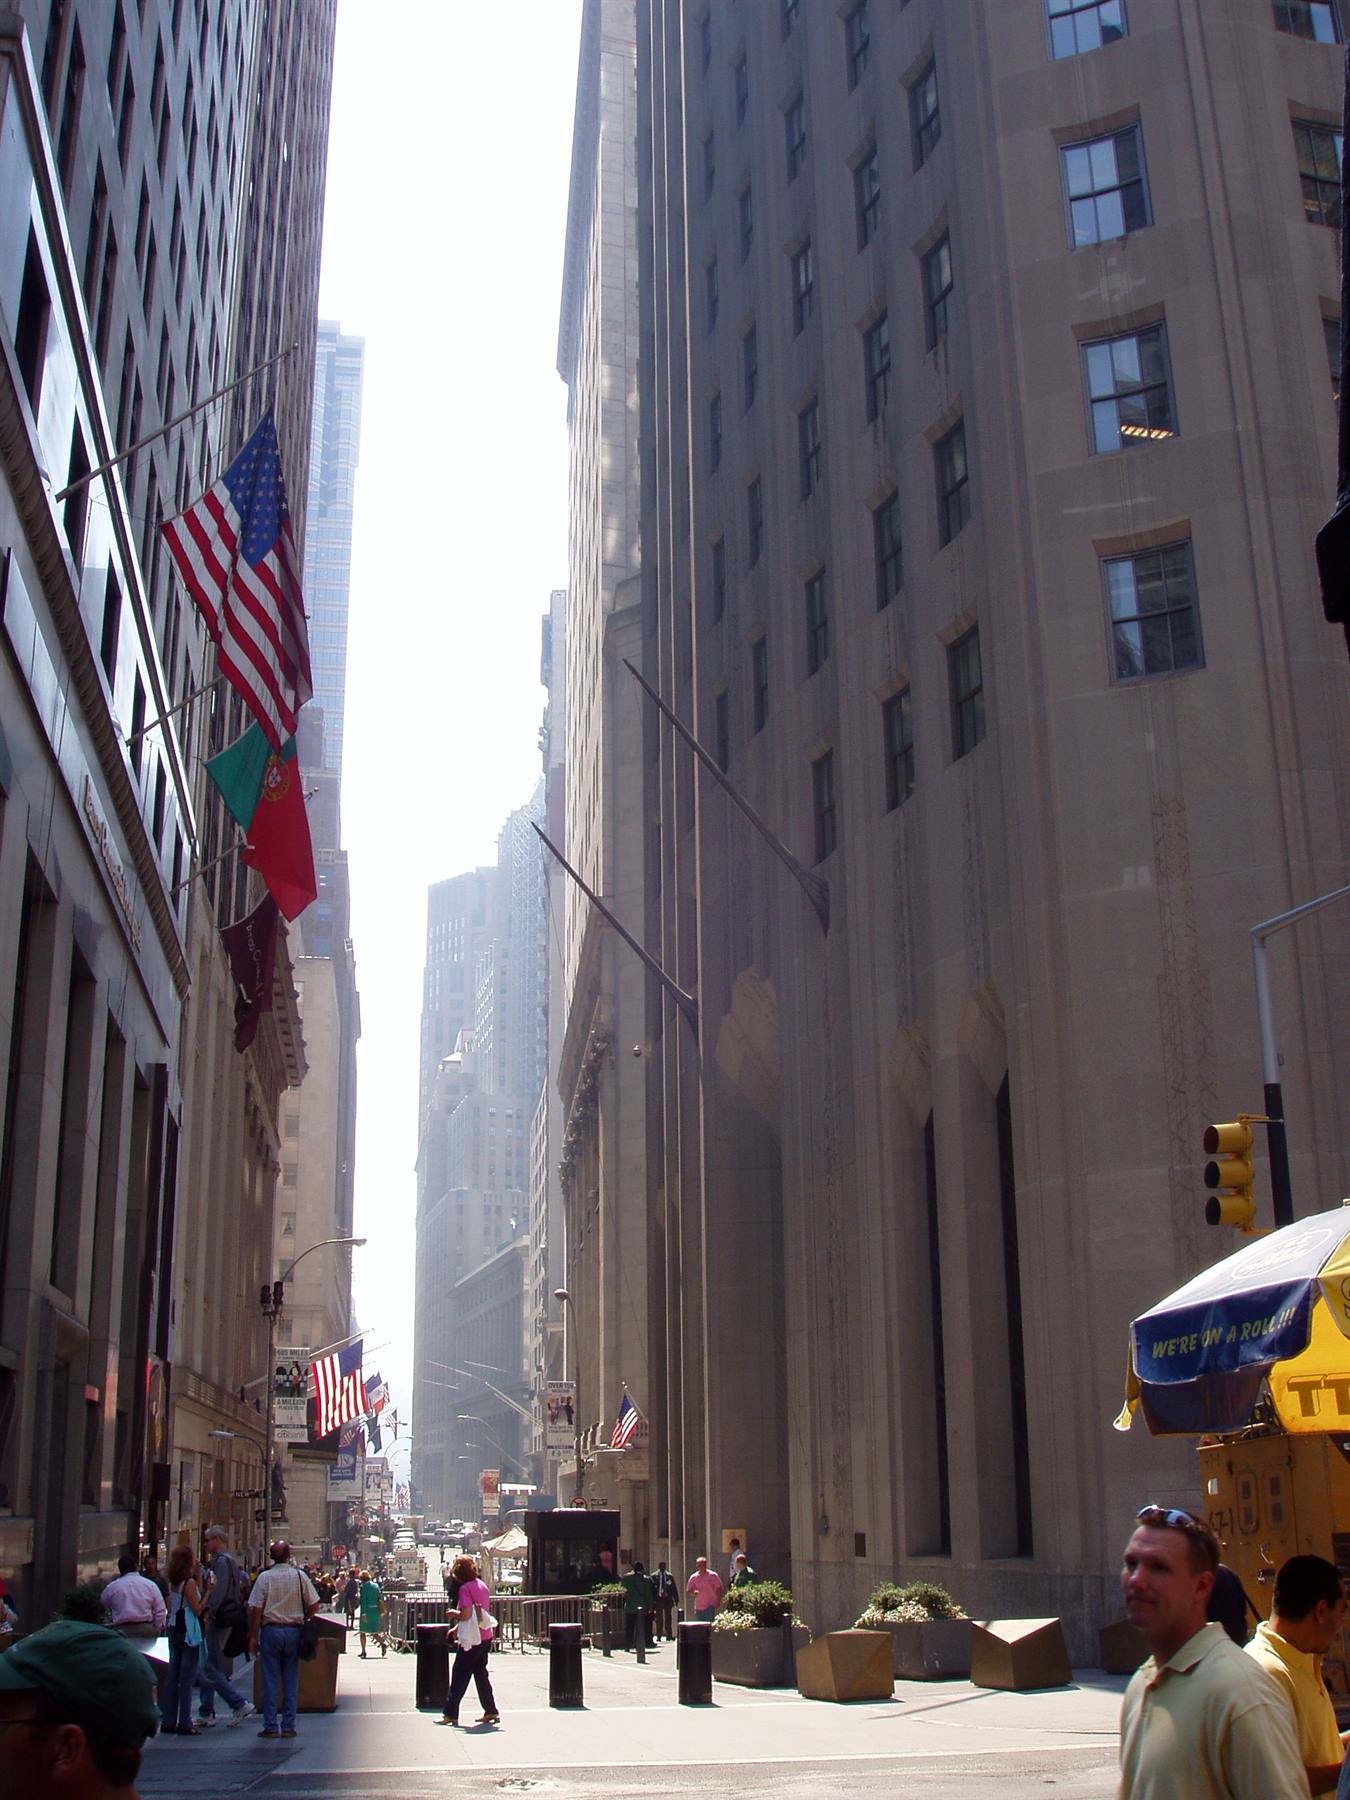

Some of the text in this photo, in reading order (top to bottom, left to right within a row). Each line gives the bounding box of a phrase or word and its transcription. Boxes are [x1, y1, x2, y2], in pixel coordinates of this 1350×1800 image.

[1152, 1333, 1198, 1359] WE'RE
[1201, 1327, 1223, 1347] ON
[1226, 1325, 1237, 1344] A
